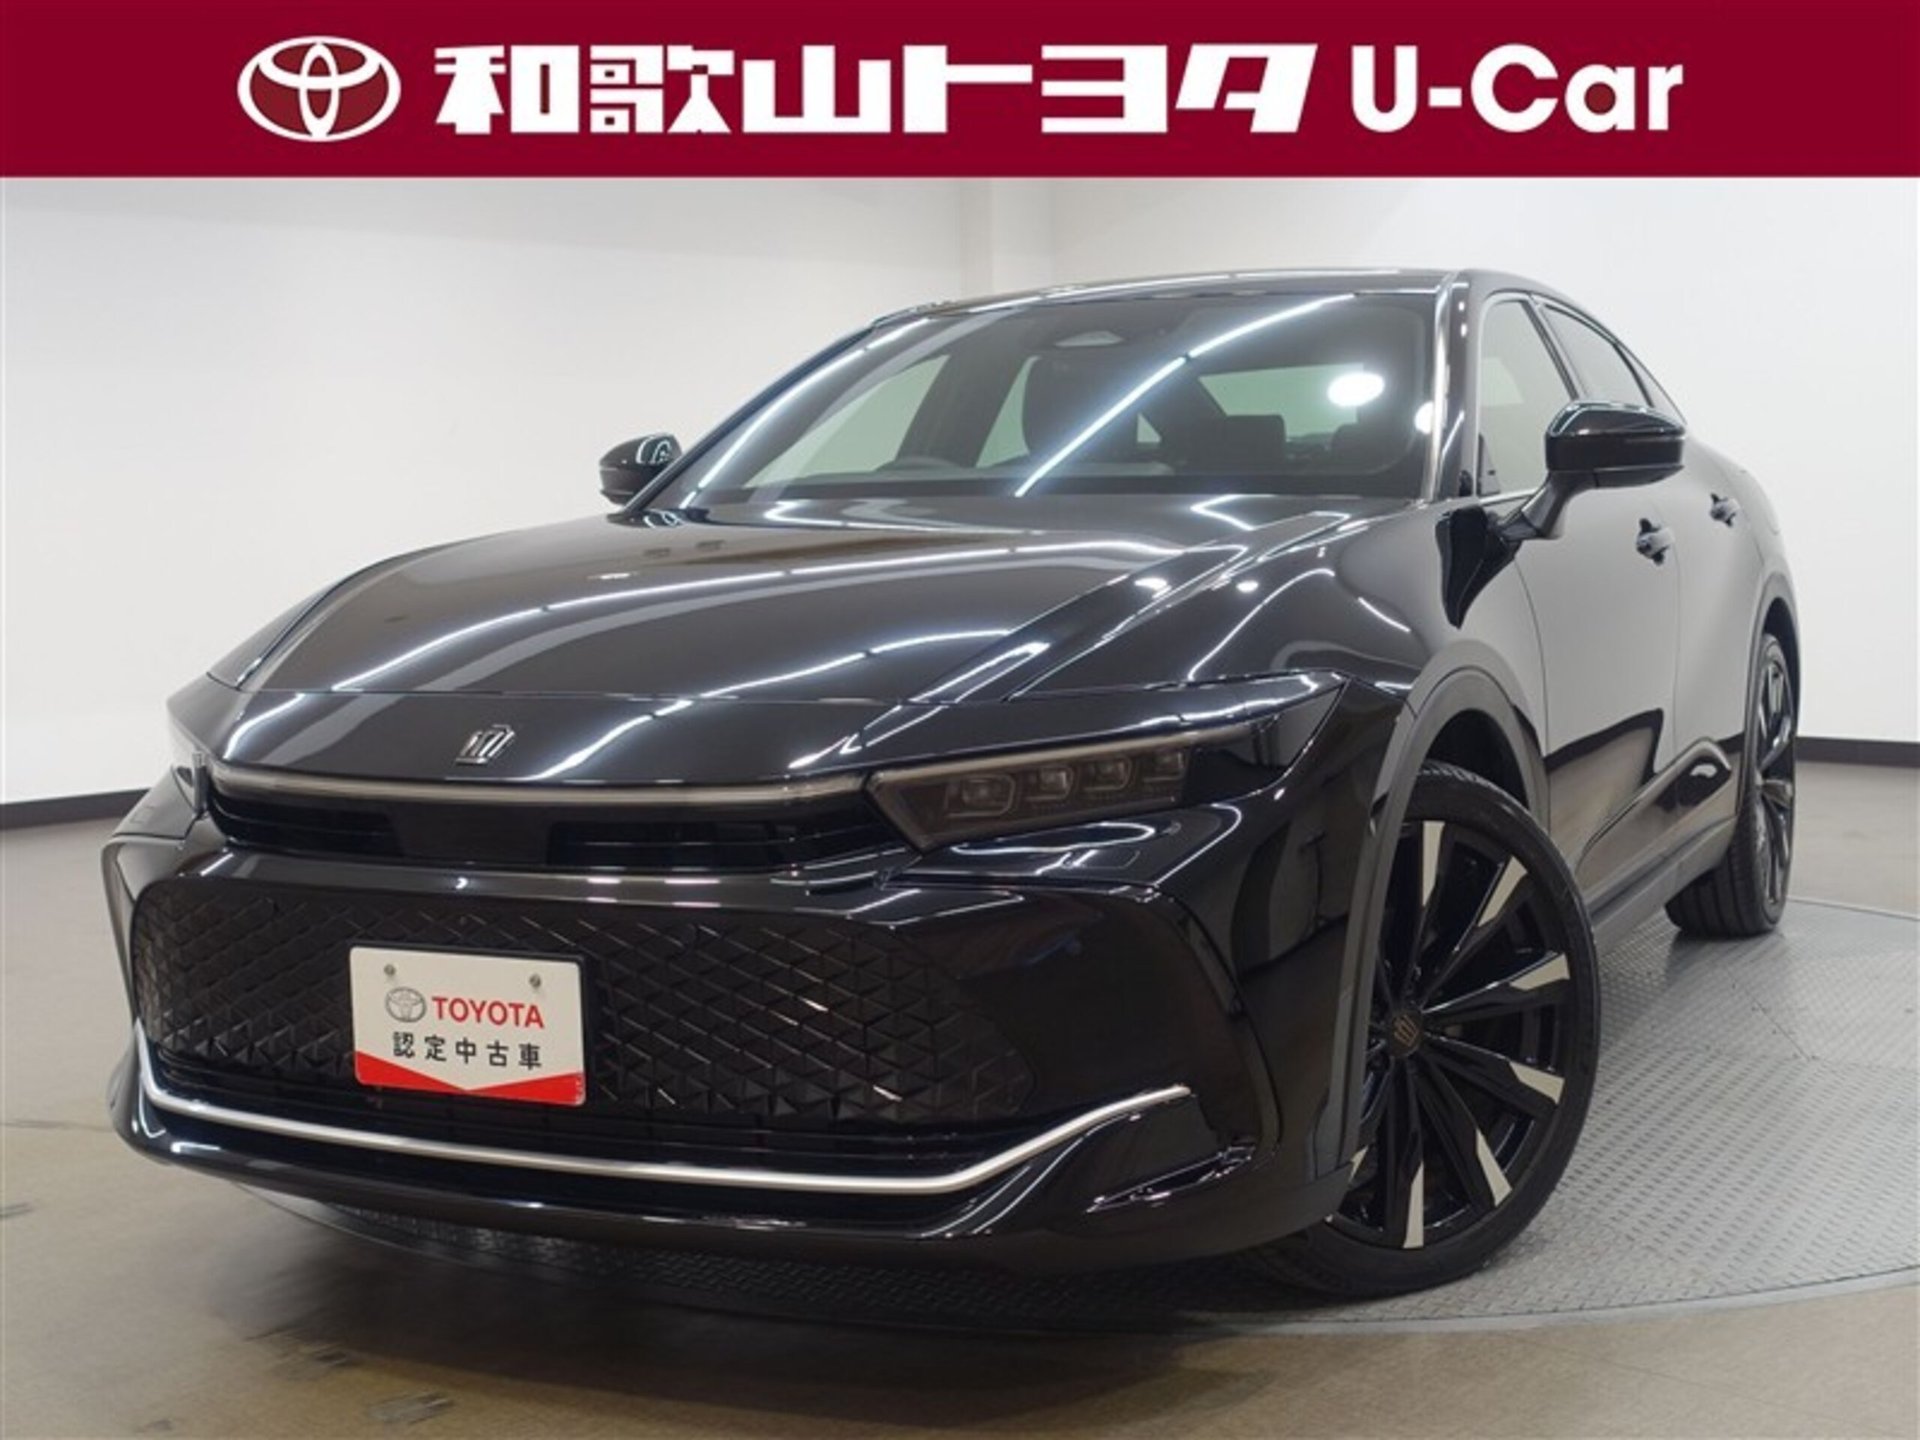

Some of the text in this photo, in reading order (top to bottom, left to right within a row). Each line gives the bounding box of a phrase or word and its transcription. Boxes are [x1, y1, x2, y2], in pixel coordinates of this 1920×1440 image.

[432, 997, 544, 1028] TOYOTA
[393, 1032, 542, 1070] 認定中古車
